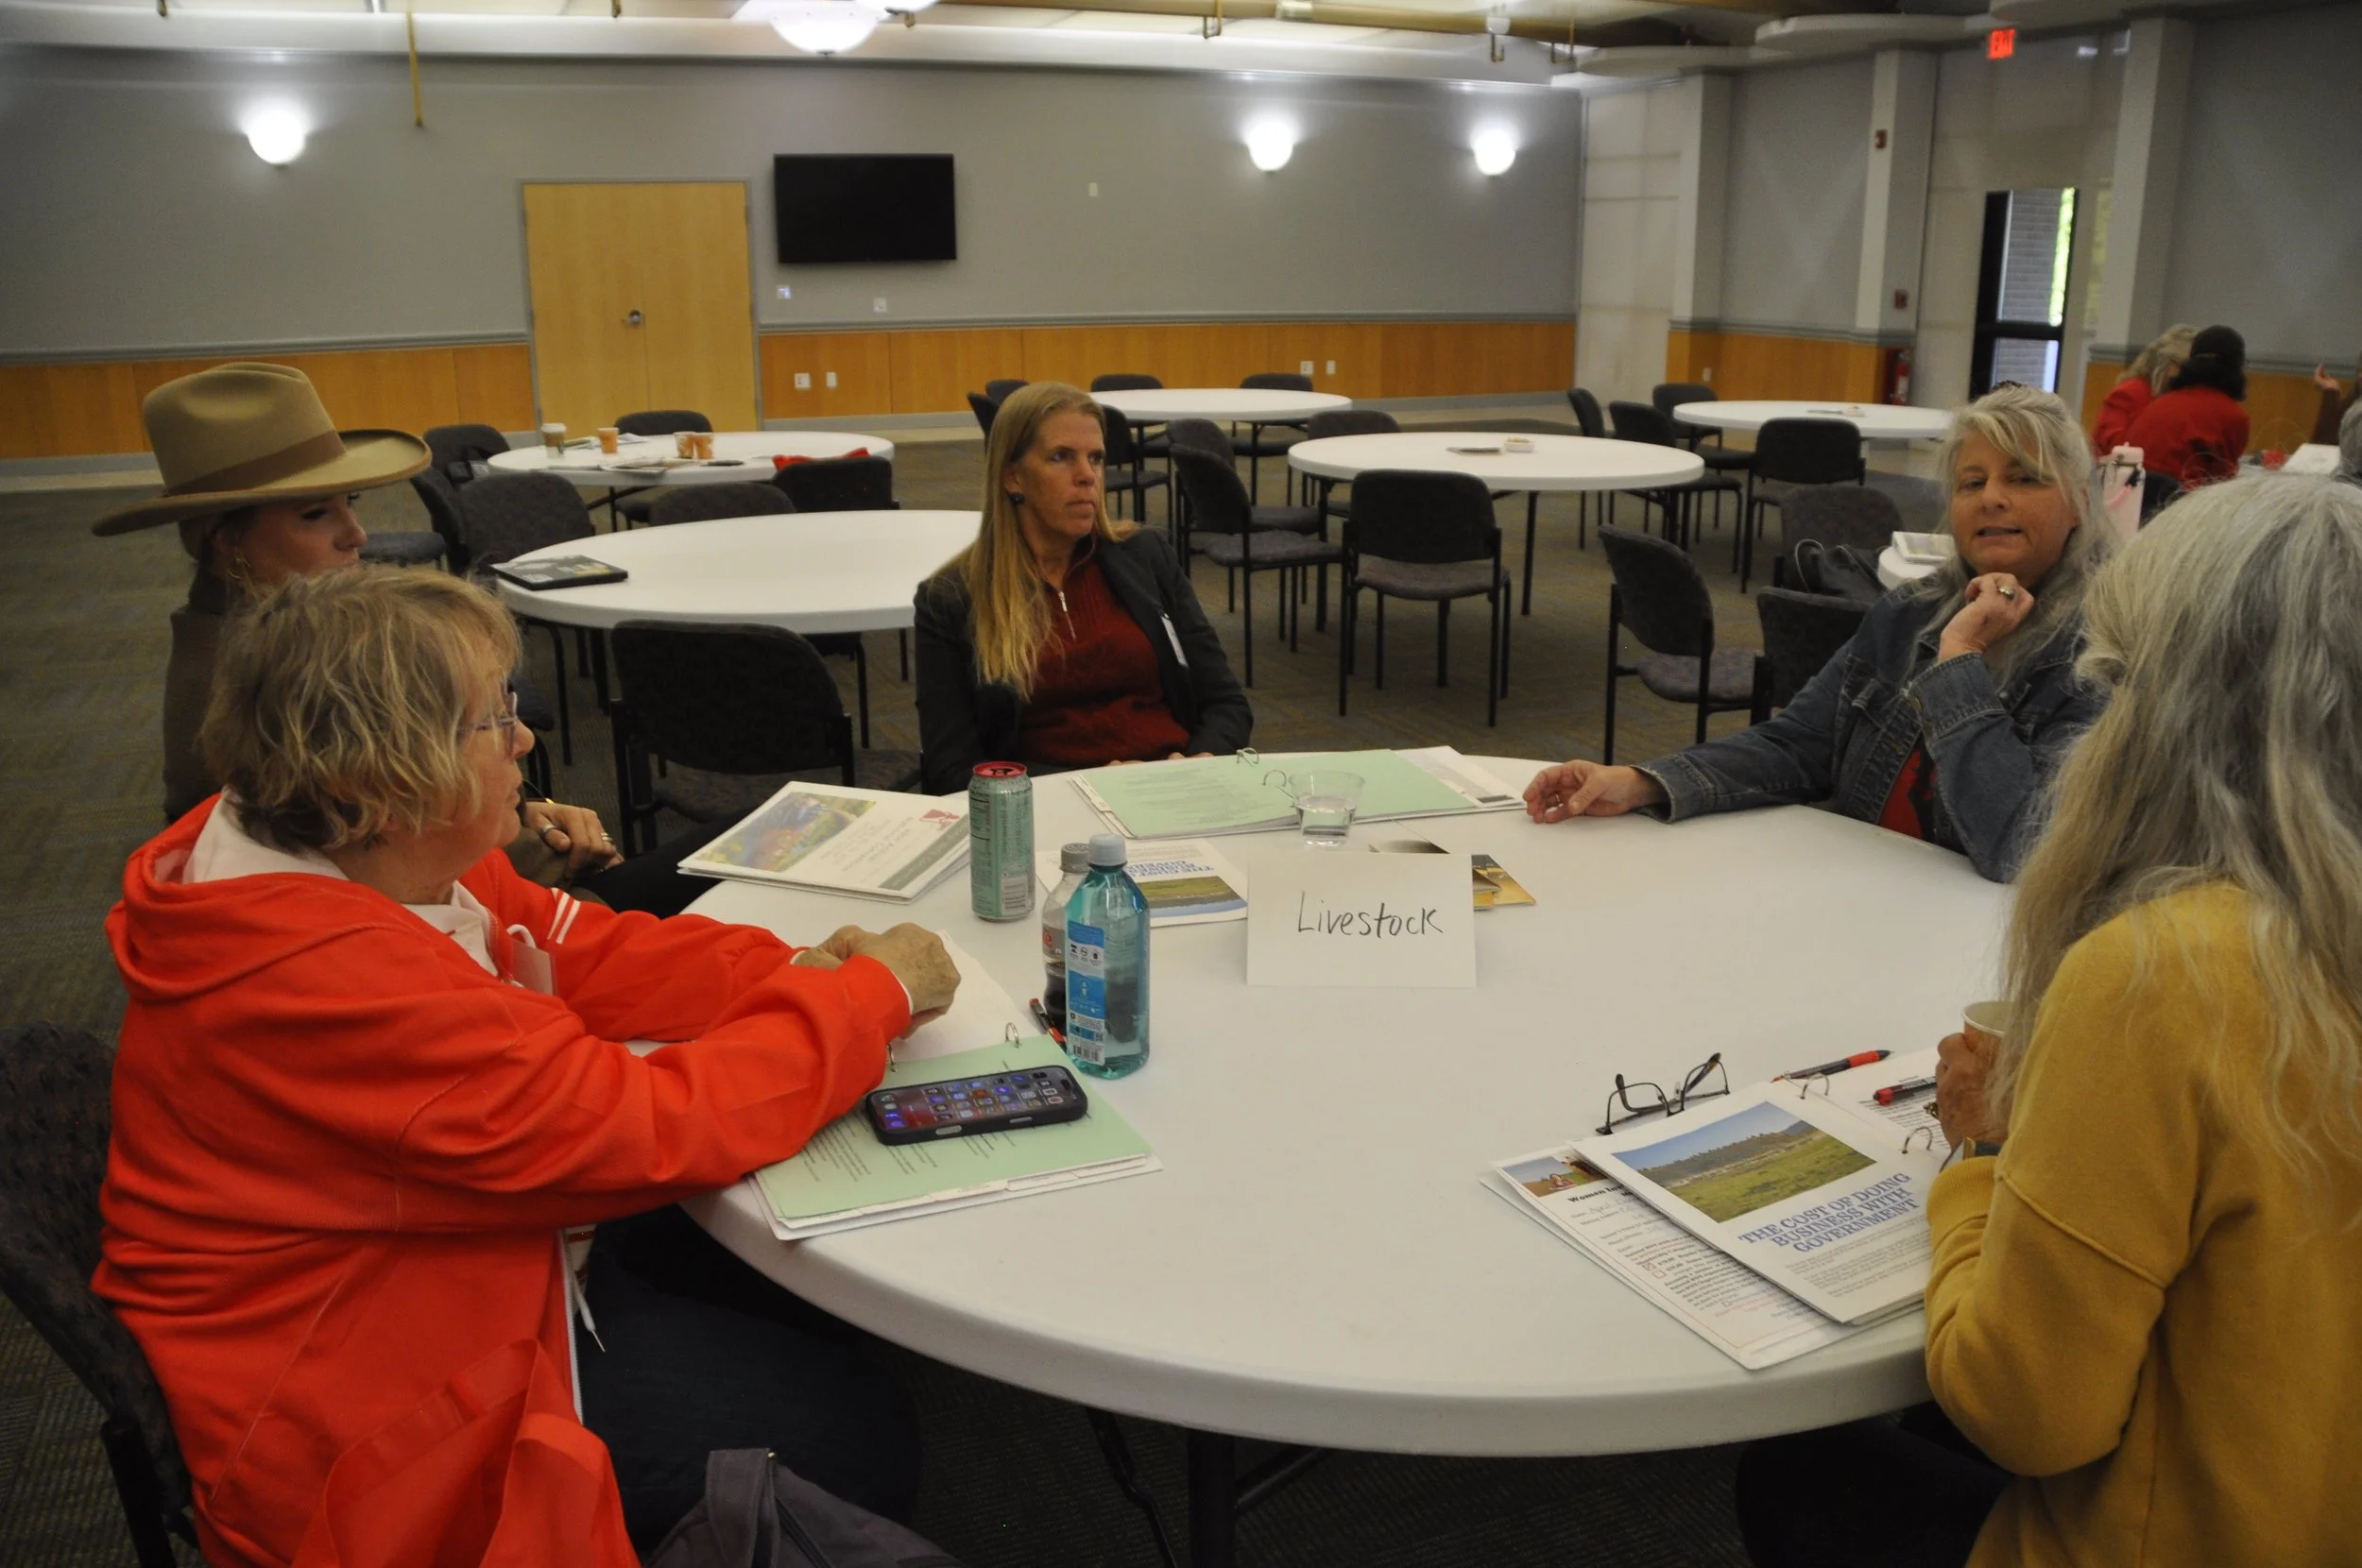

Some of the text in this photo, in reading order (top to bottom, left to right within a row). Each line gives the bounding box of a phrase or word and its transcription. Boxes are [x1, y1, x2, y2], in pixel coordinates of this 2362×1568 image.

[1989, 29, 2014, 60] EXIT
[1298, 890, 1444, 939] Livestock
[1567, 1188, 1605, 1202] Women
[1738, 1172, 1912, 1243] THE COST OF DOING
[1770, 1187, 1914, 1247] BUSINESS WITH
[1793, 1198, 1920, 1253] GOVERNMENT
